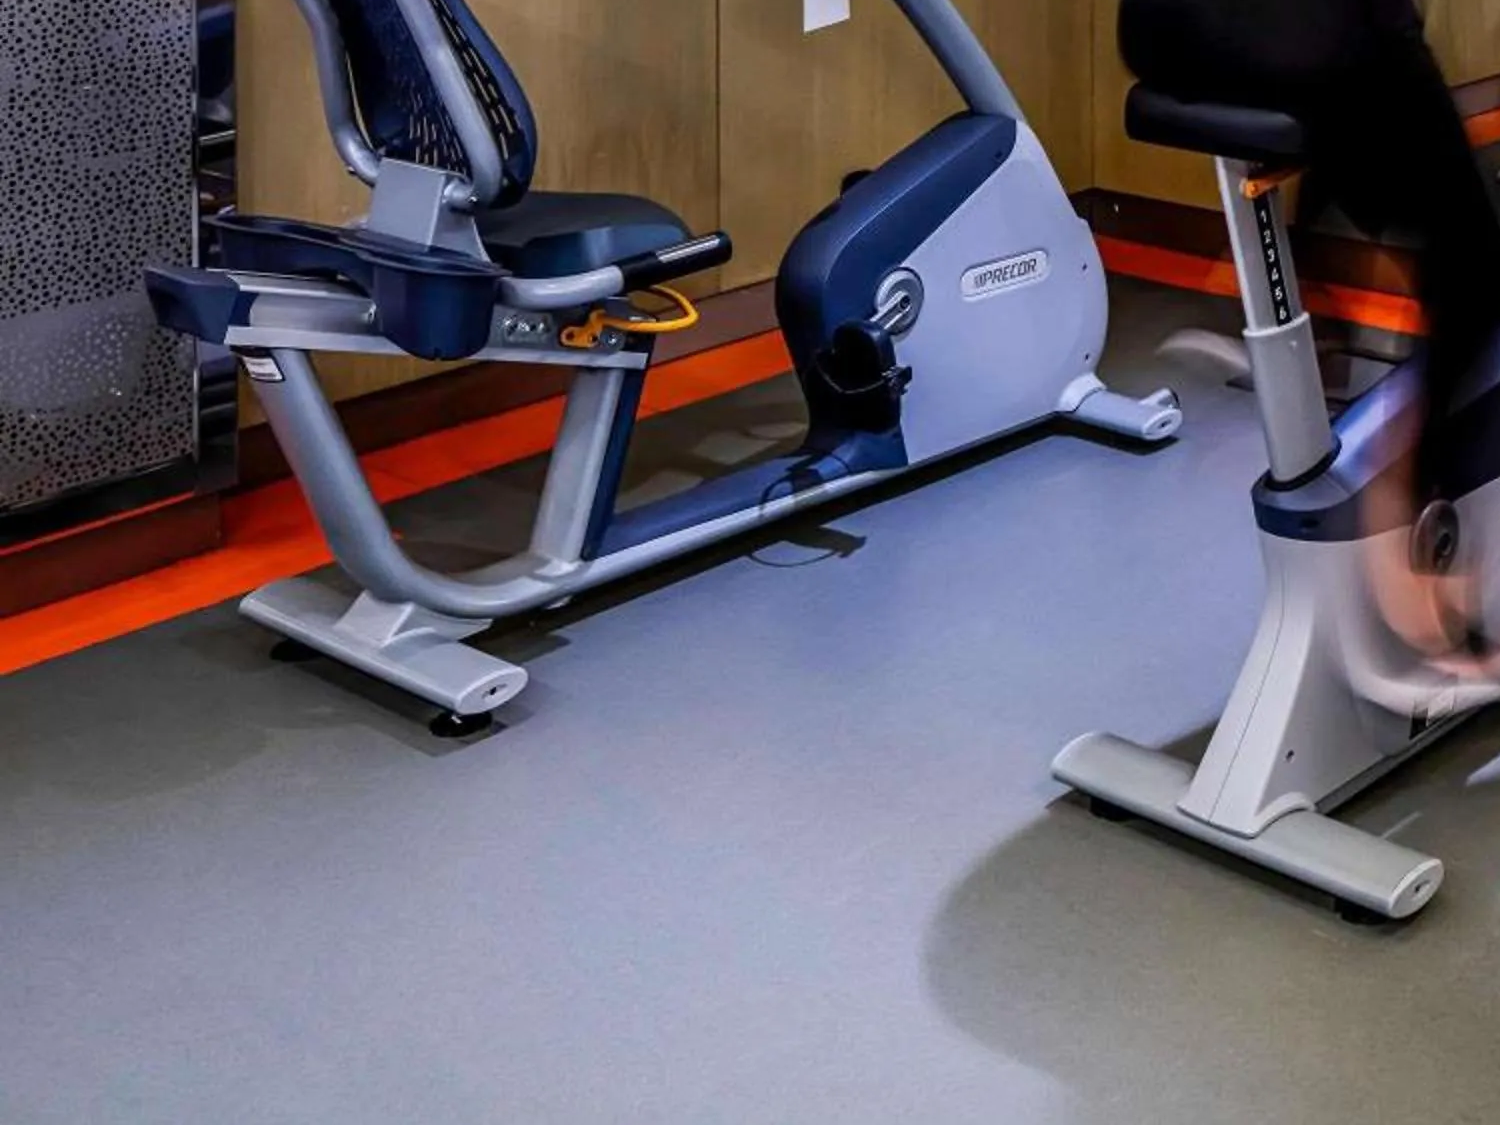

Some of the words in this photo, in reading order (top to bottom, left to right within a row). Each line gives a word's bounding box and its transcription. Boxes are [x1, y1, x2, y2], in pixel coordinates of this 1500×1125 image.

[1261, 210, 1267, 223] 1
[1264, 230, 1271, 244] 2
[1268, 248, 1275, 263] 3
[984, 258, 1037, 287] PRECOR
[1272, 267, 1279, 281] 4
[1275, 286, 1283, 300] 5
[1280, 306, 1287, 320] 6
